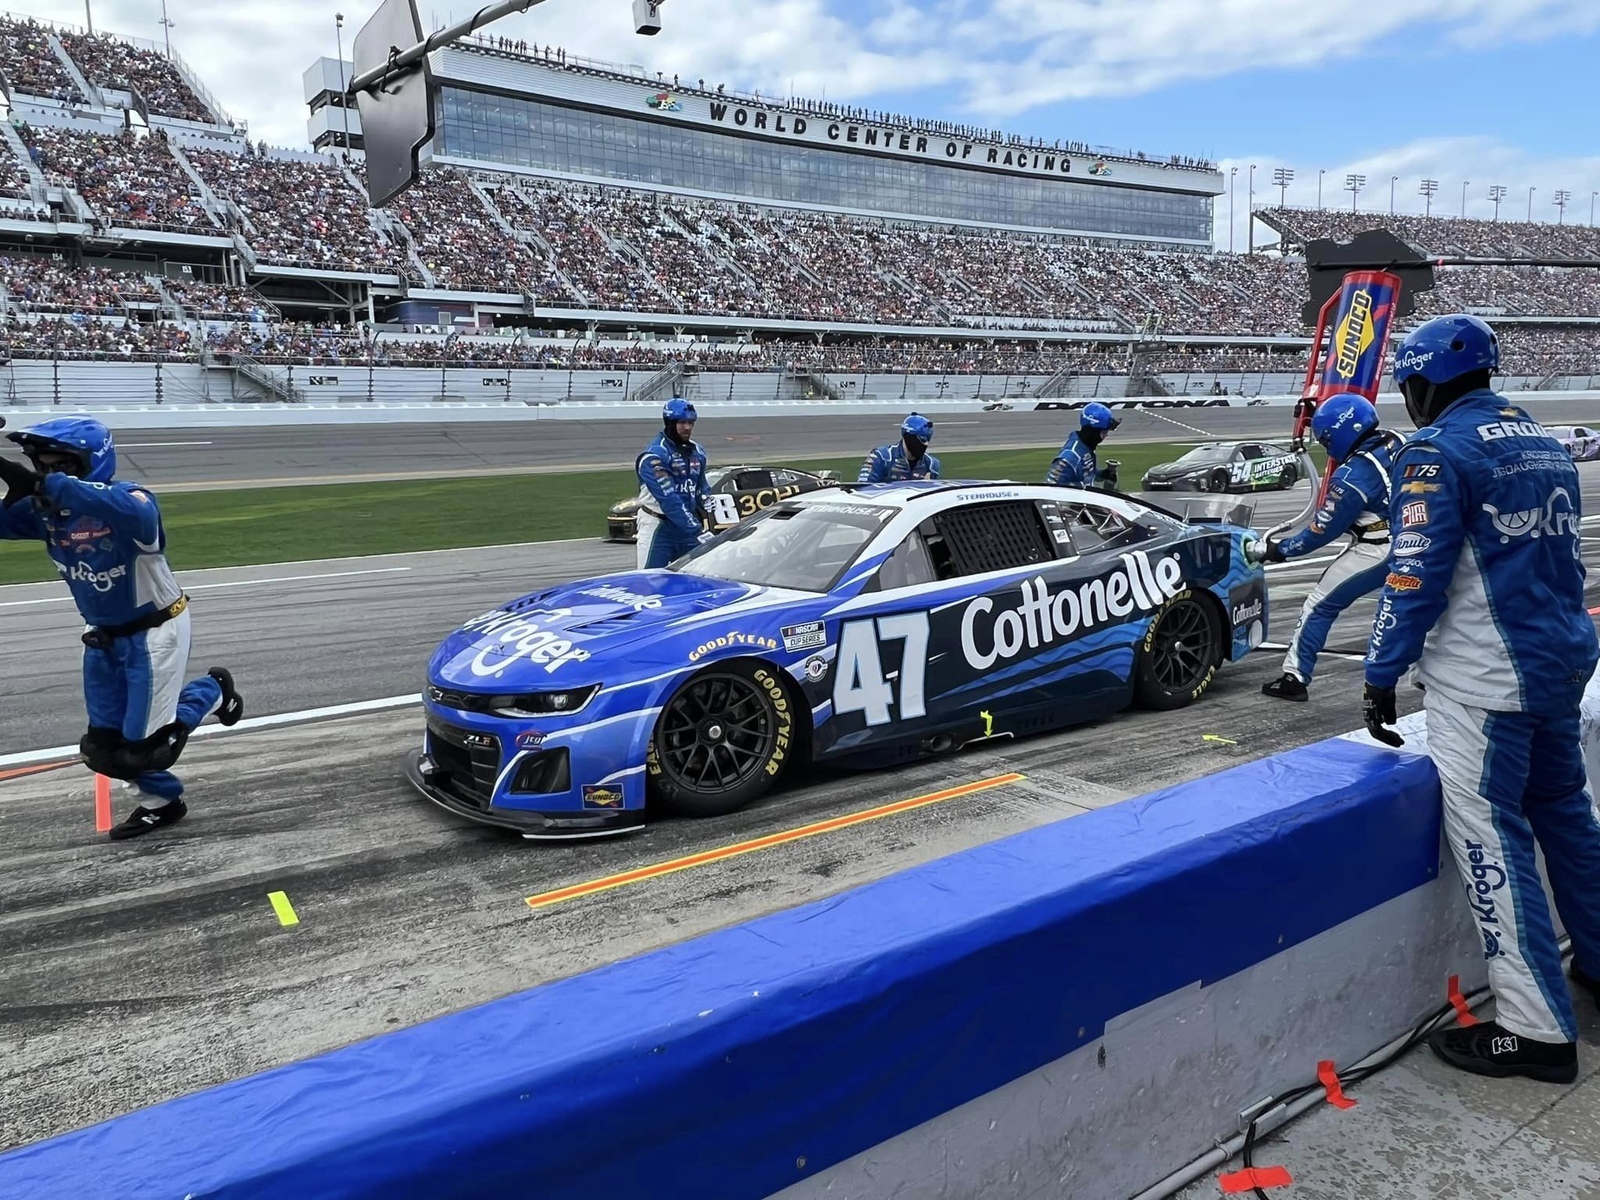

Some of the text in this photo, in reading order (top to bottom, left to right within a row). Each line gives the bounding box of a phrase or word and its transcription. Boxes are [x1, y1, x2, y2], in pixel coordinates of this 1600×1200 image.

[709, 102, 1071, 173] WORLD CENTER OF RACING
[1338, 291, 1371, 377] SUNOCO
[1402, 350, 1434, 371] Kroger
[1231, 462, 1252, 483] 54
[1254, 453, 1297, 473] INTERSTATE
[1417, 465, 1440, 477] 75
[956, 491, 1013, 501] STENHOUSE
[70, 561, 126, 592] Kroger
[960, 550, 1187, 670] Cottonelle
[1232, 598, 1262, 626] Cottonelle
[1372, 595, 1397, 647] Kroger
[471, 608, 592, 678] Kroger
[795, 623, 819, 635] NASCAR
[688, 630, 778, 661] GOODYEAR
[832, 611, 931, 727] 47
[1191, 665, 1216, 699] EAGLE
[753, 669, 791, 776] GOODYEAR
[585, 792, 620, 801] SUNOCO
[1465, 838, 1507, 924] Kroger
[1492, 1036, 1518, 1055] K1
